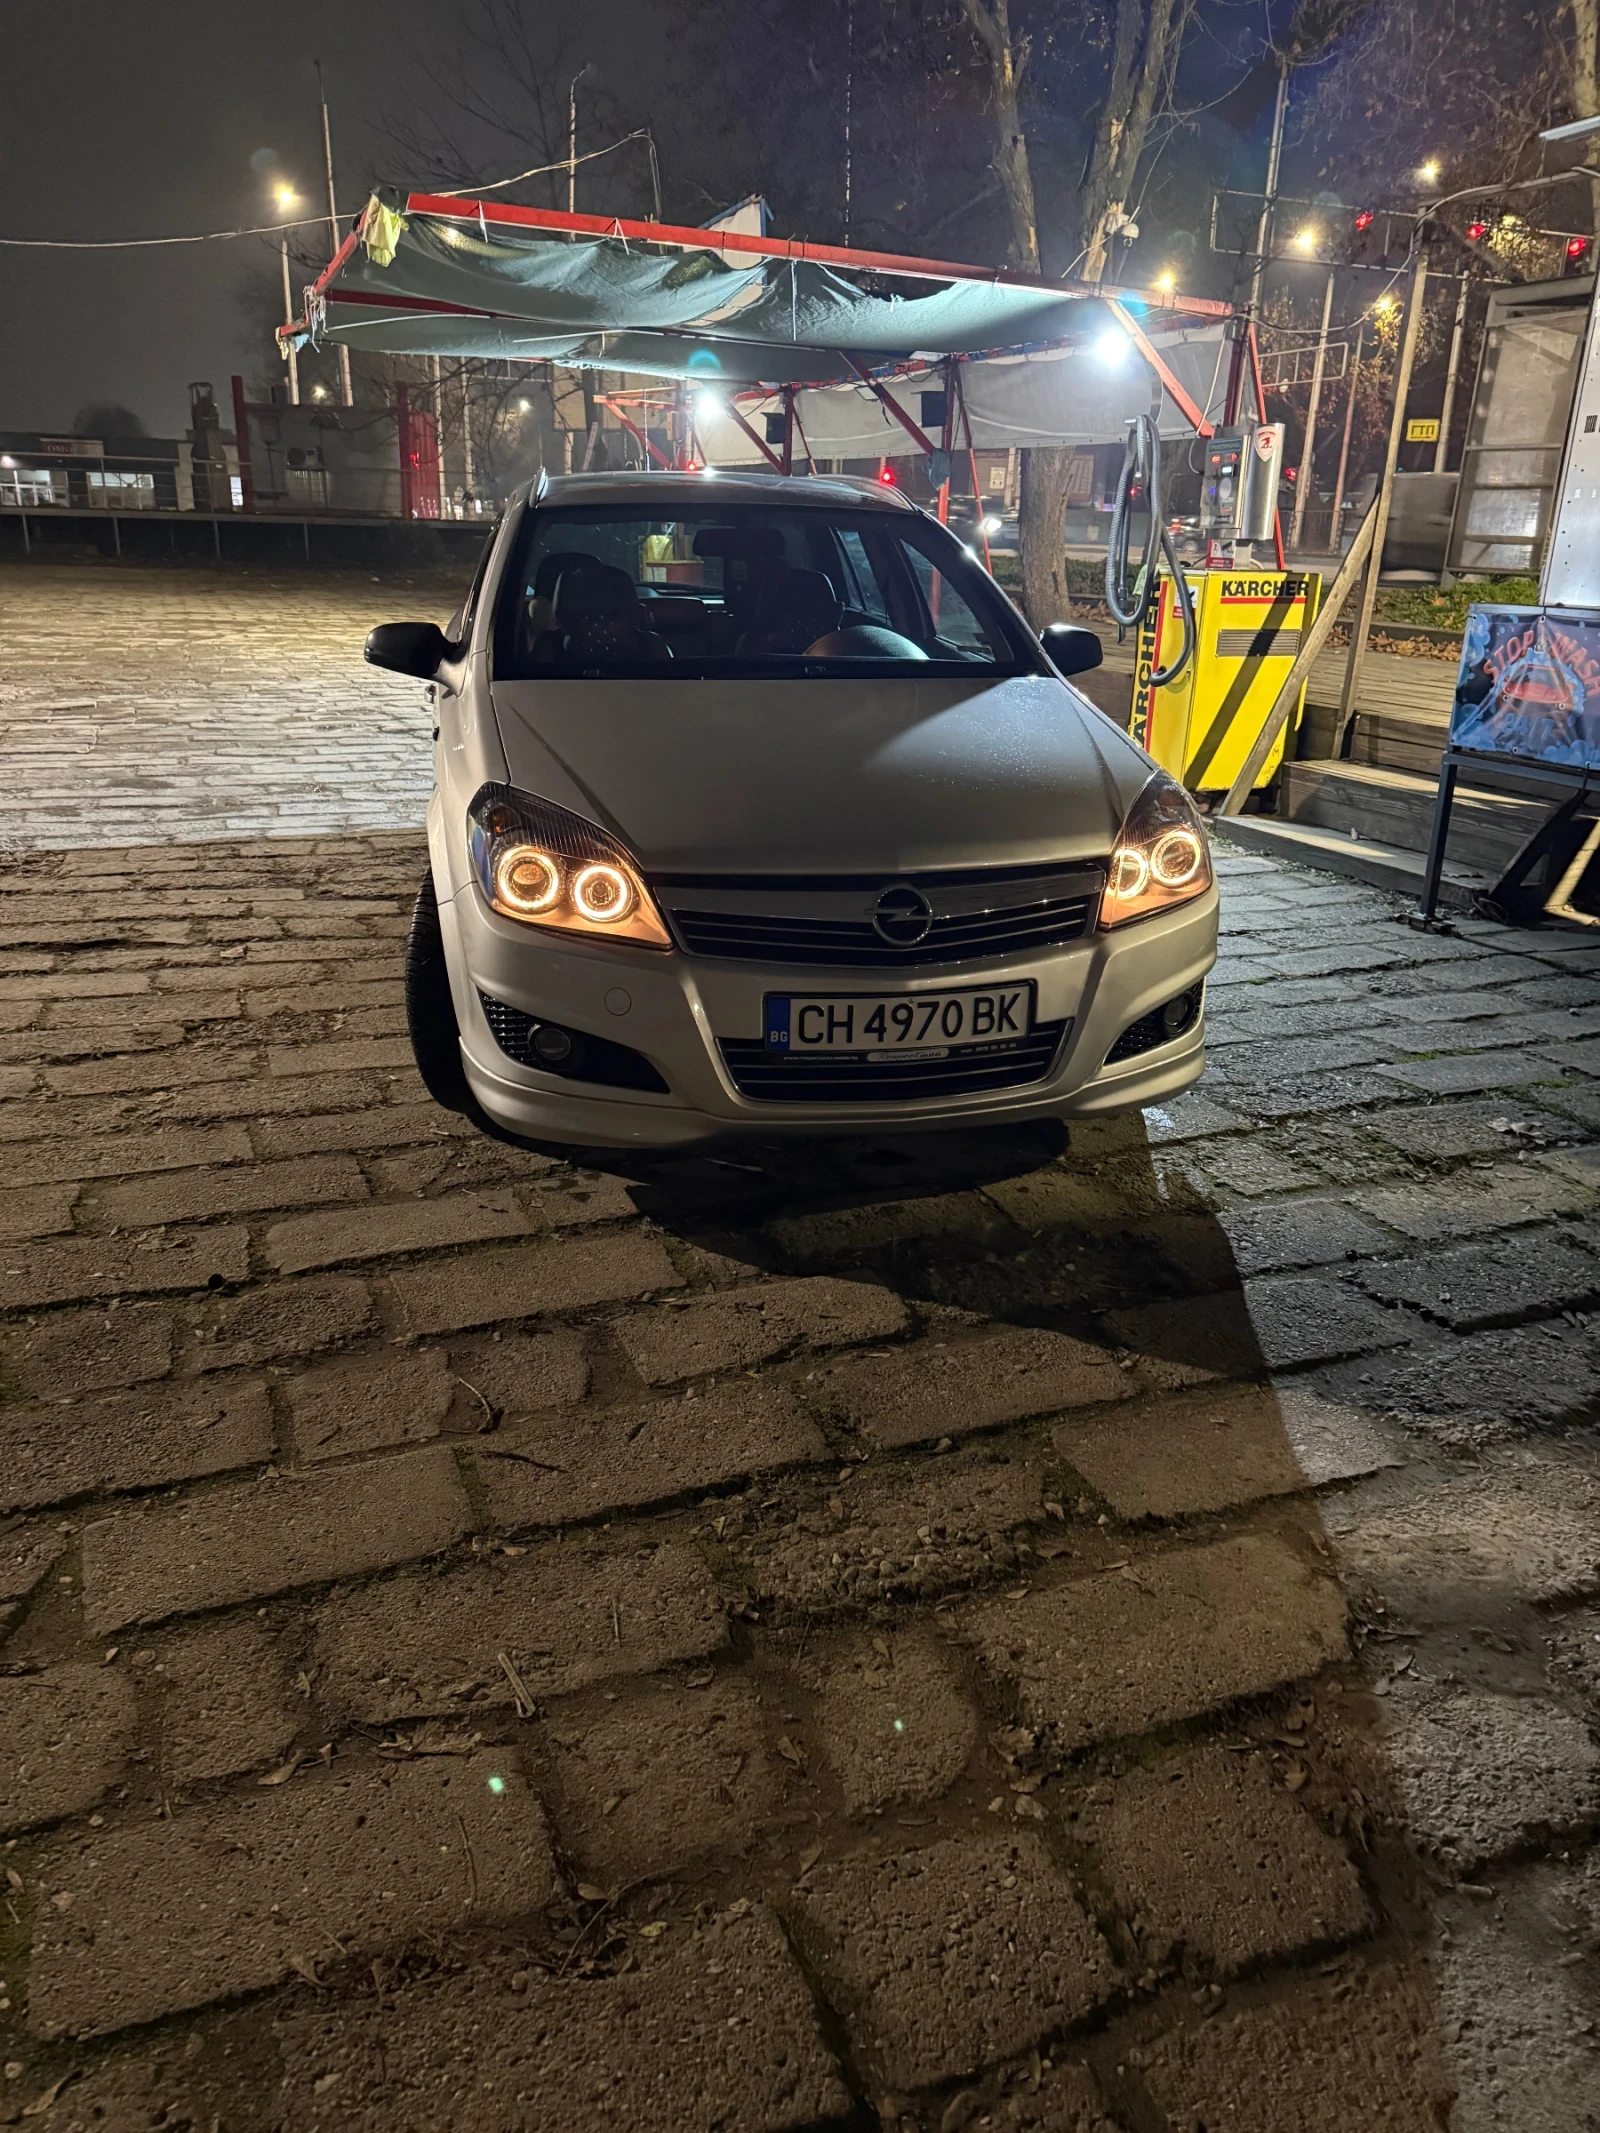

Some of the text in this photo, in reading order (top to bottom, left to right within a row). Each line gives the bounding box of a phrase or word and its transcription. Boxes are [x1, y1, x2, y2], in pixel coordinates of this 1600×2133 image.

[1220, 579, 1310, 598] KÄRCHER
[1483, 630, 1535, 684] STOP
[1502, 712, 1554, 741] 24/7
[798, 993, 1022, 1044] CH 4970 BK
[770, 1030, 788, 1043] BG
